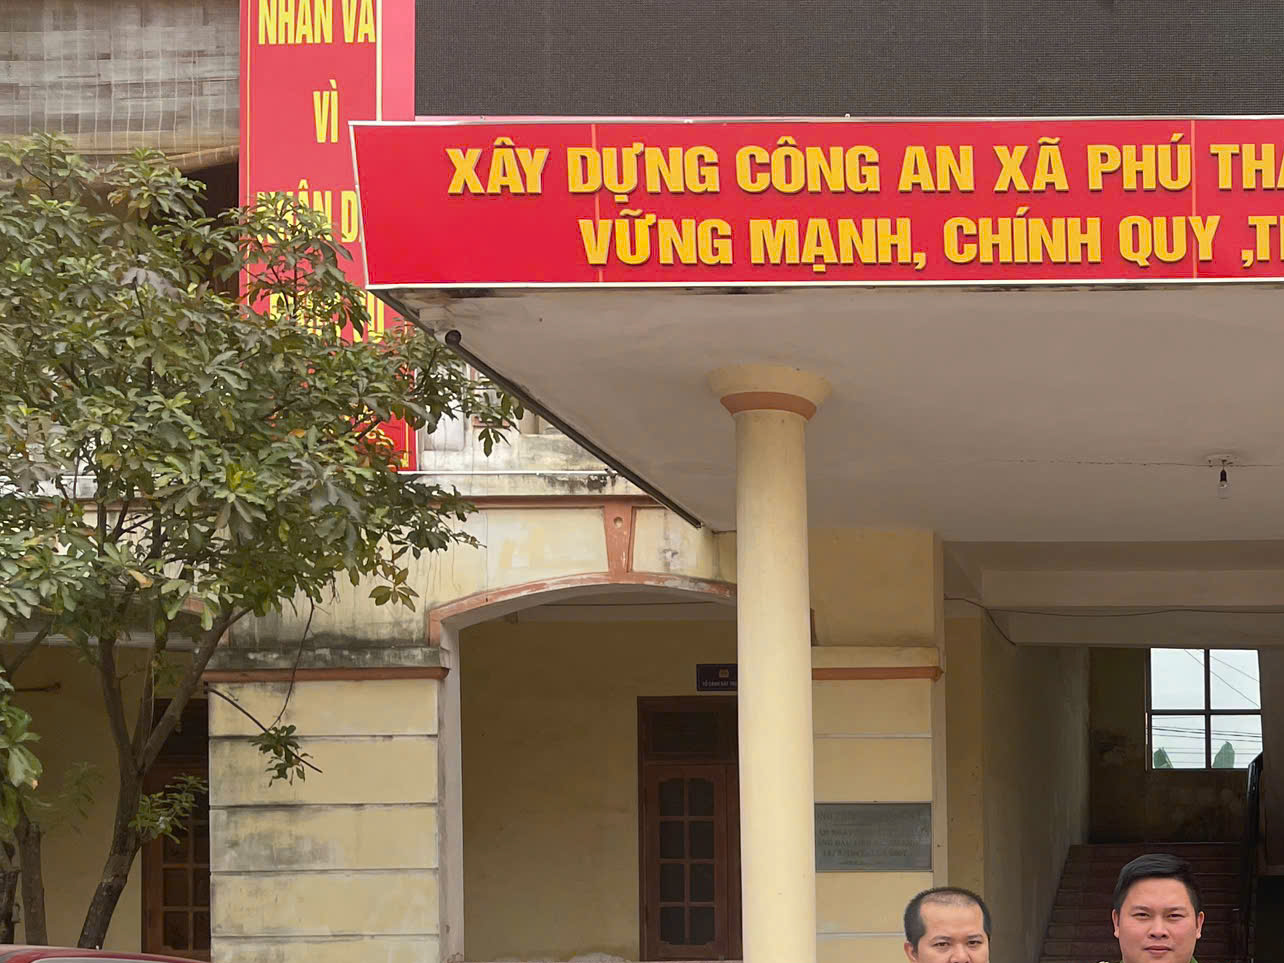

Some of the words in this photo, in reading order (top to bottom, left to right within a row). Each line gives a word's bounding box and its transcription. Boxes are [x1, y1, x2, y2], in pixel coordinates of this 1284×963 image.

[313, 79, 339, 143] VÌ
[446, 137, 549, 194] XÂY
[567, 142, 720, 203] DỰNG
[735, 136, 881, 193] CÔNG
[898, 145, 974, 191] AN
[994, 136, 1069, 191] XÃ
[1087, 133, 1191, 190] PHÚ
[578, 208, 733, 265] VỮNG
[749, 218, 926, 273] MẠNH,
[943, 207, 1102, 263] CHÍNH
[1119, 215, 1221, 267] QUY
